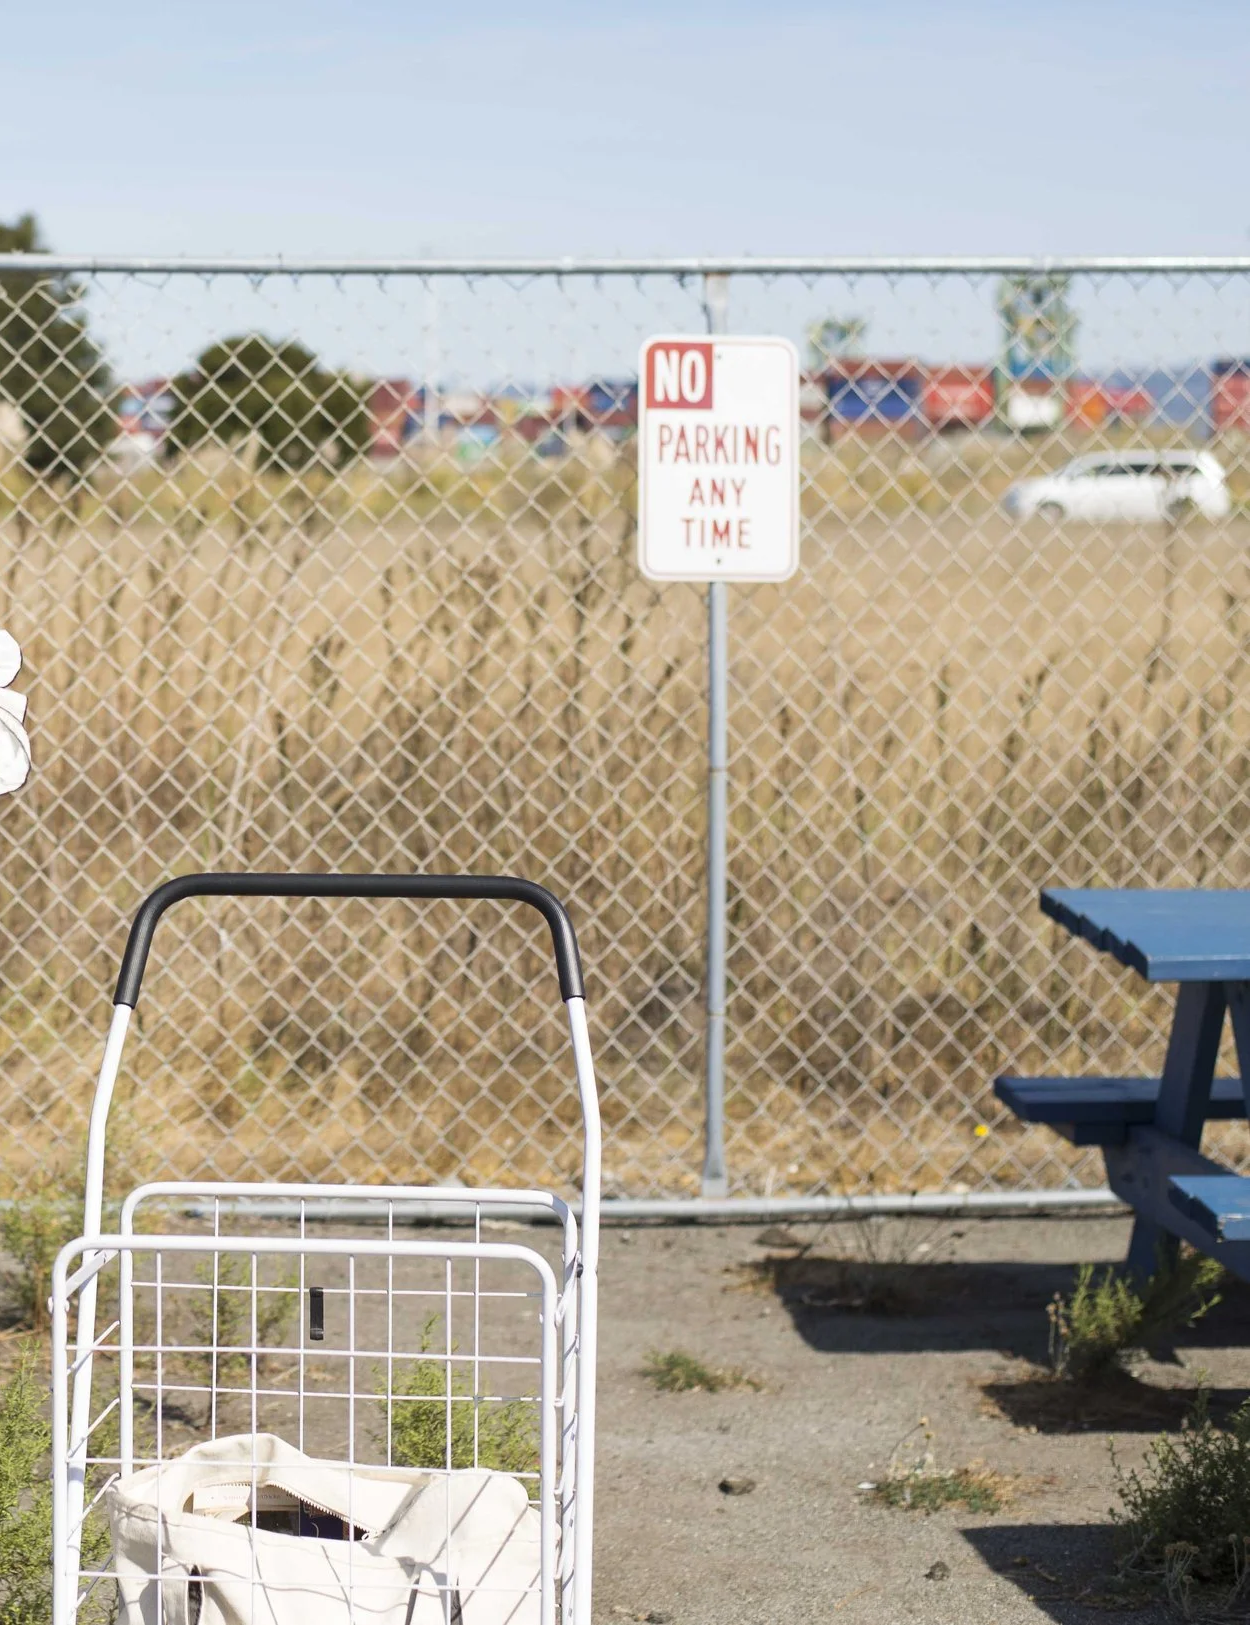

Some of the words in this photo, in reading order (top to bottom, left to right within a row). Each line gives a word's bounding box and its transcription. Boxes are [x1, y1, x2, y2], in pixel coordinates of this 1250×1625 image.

[653, 349, 707, 404] NO
[658, 424, 782, 467] PARKING
[689, 477, 747, 507] ANY
[682, 517, 752, 549] TIME
